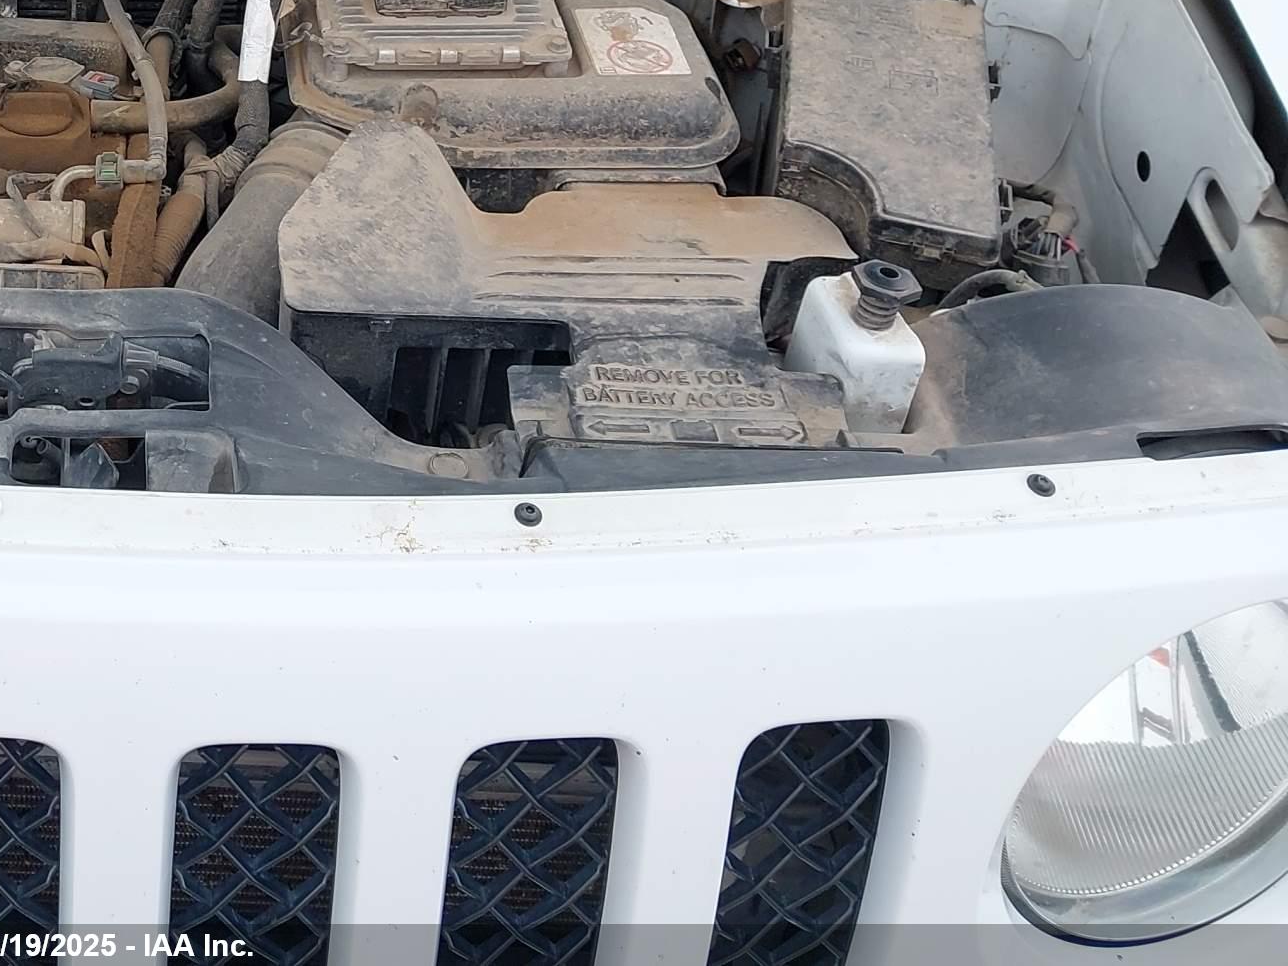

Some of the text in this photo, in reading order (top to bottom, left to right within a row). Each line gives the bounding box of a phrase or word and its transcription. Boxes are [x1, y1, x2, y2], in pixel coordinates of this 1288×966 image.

[596, 367, 743, 385] REMOVE FOR
[582, 388, 775, 408] BATTERY ACCESS
